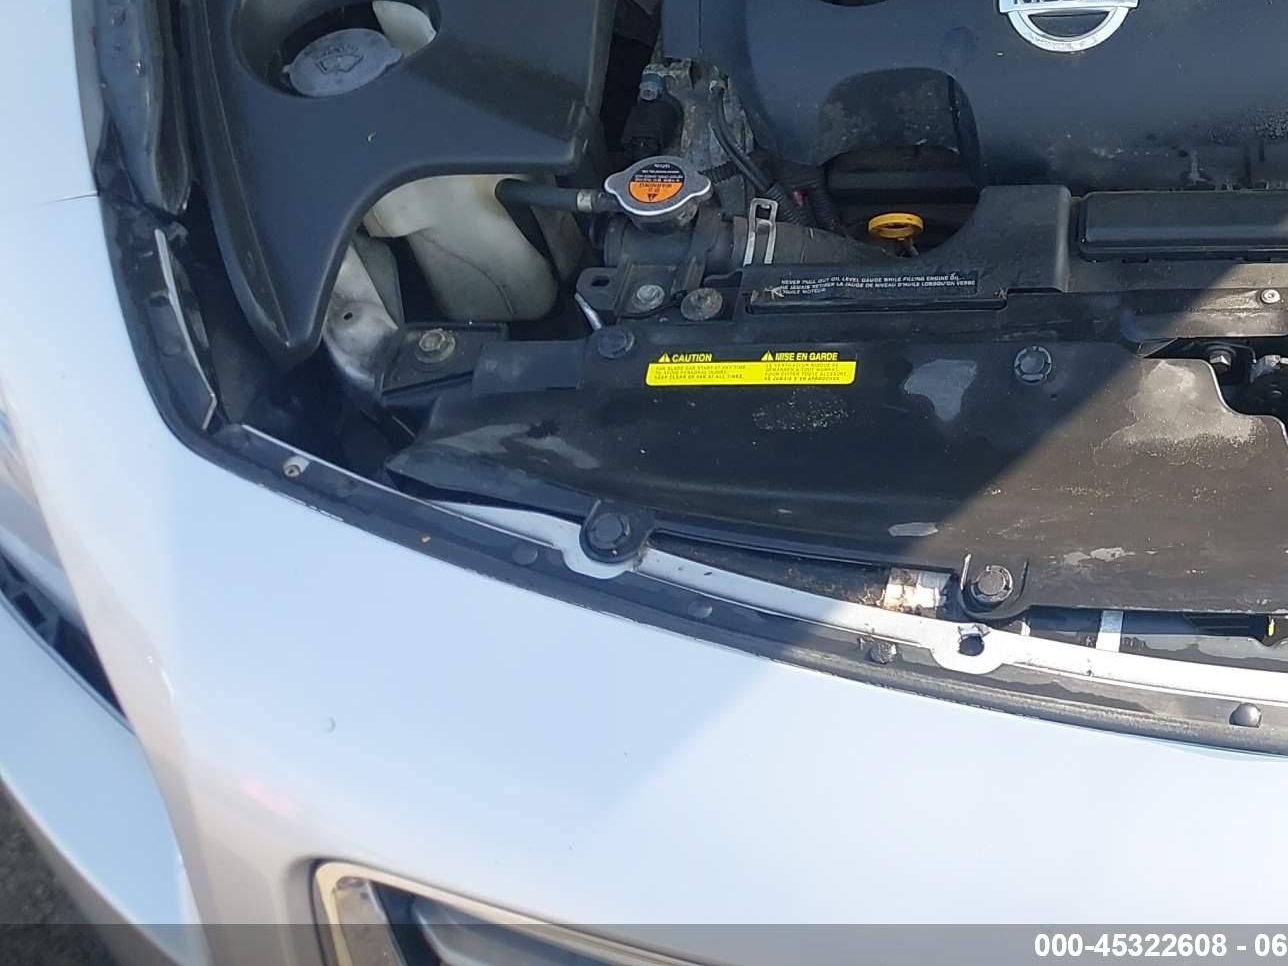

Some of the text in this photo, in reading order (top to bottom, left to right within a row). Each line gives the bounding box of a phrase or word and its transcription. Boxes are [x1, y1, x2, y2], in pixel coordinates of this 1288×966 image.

[671, 353, 712, 362] CAUTION
[774, 352, 839, 361] MISE EN GARDE
